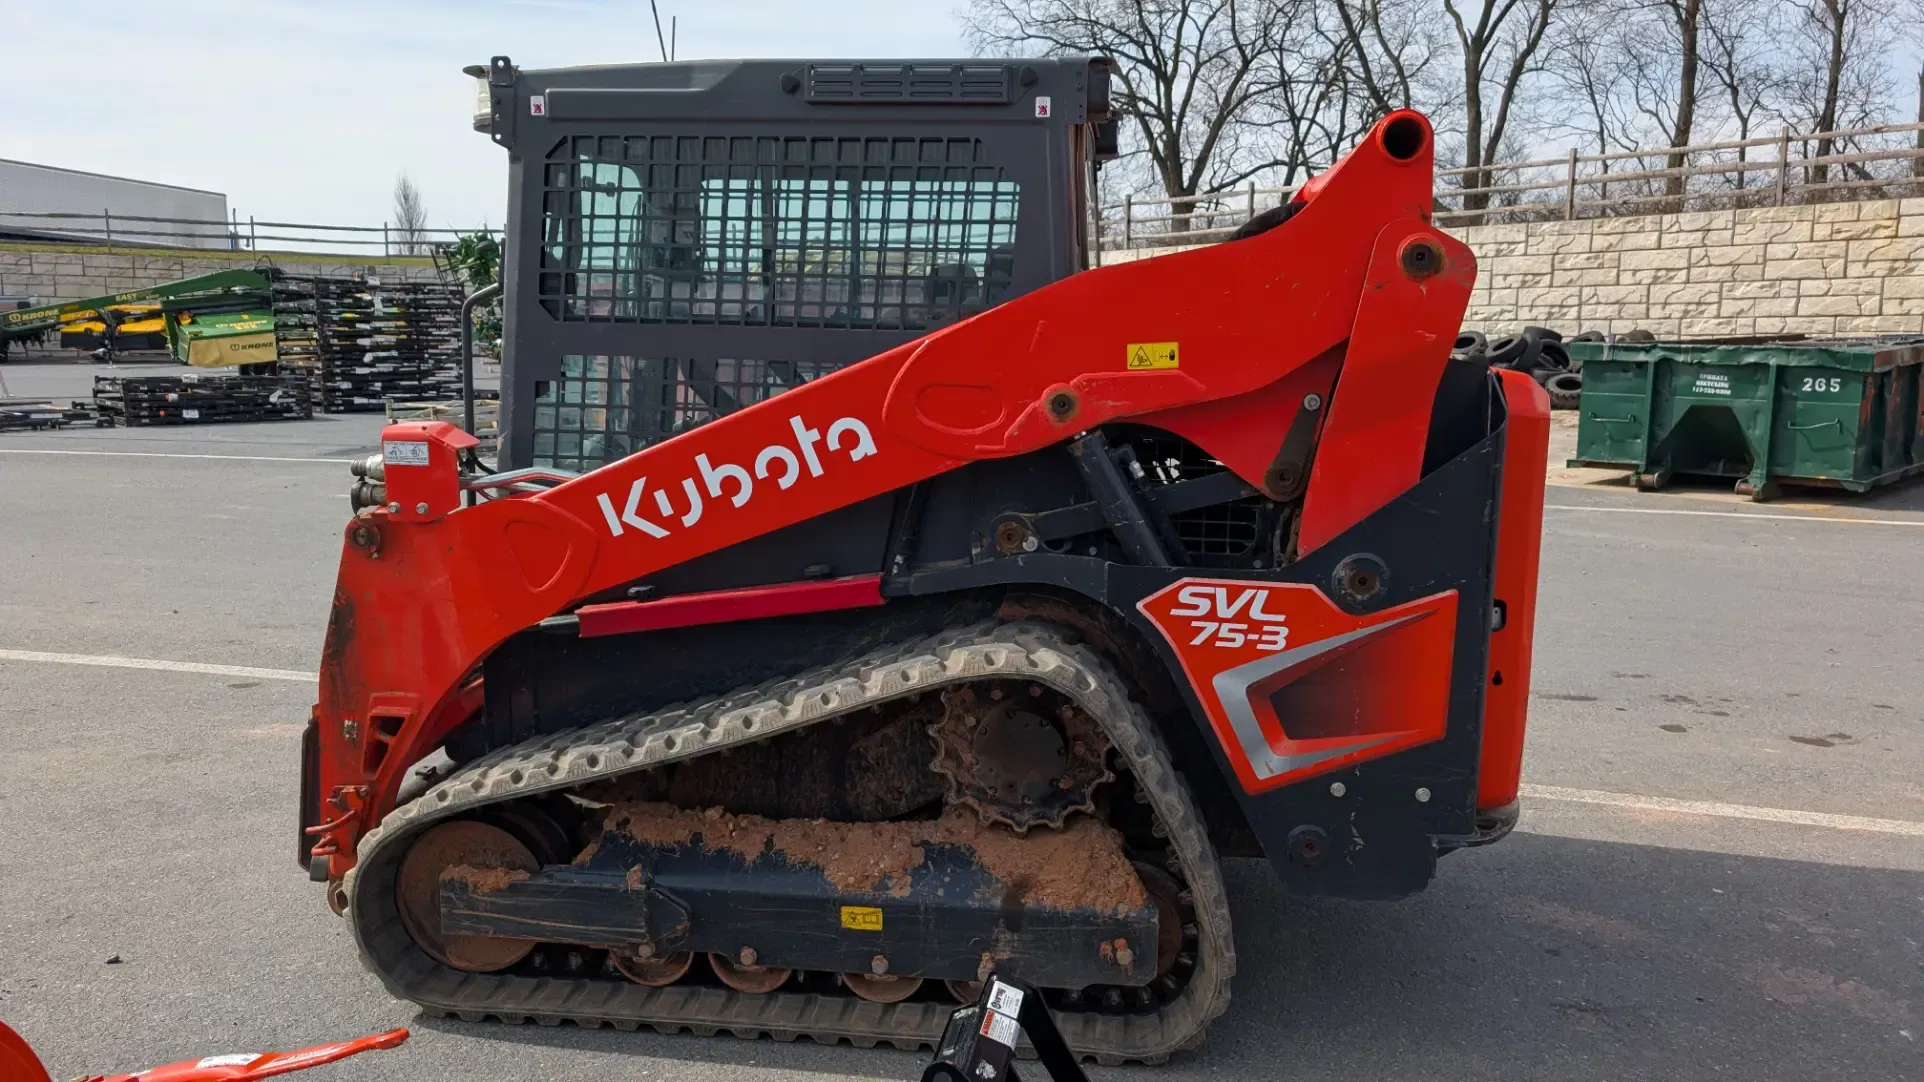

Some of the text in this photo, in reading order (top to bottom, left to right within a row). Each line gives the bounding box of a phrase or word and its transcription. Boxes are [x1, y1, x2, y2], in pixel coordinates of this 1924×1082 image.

[22, 308, 59, 320] KRONE
[241, 341, 274, 350] KRONE
[1802, 377, 1841, 393] 265
[596, 415, 878, 539] Kubota
[1170, 586, 1287, 622] SVL
[1189, 621, 1289, 651] 75-3
